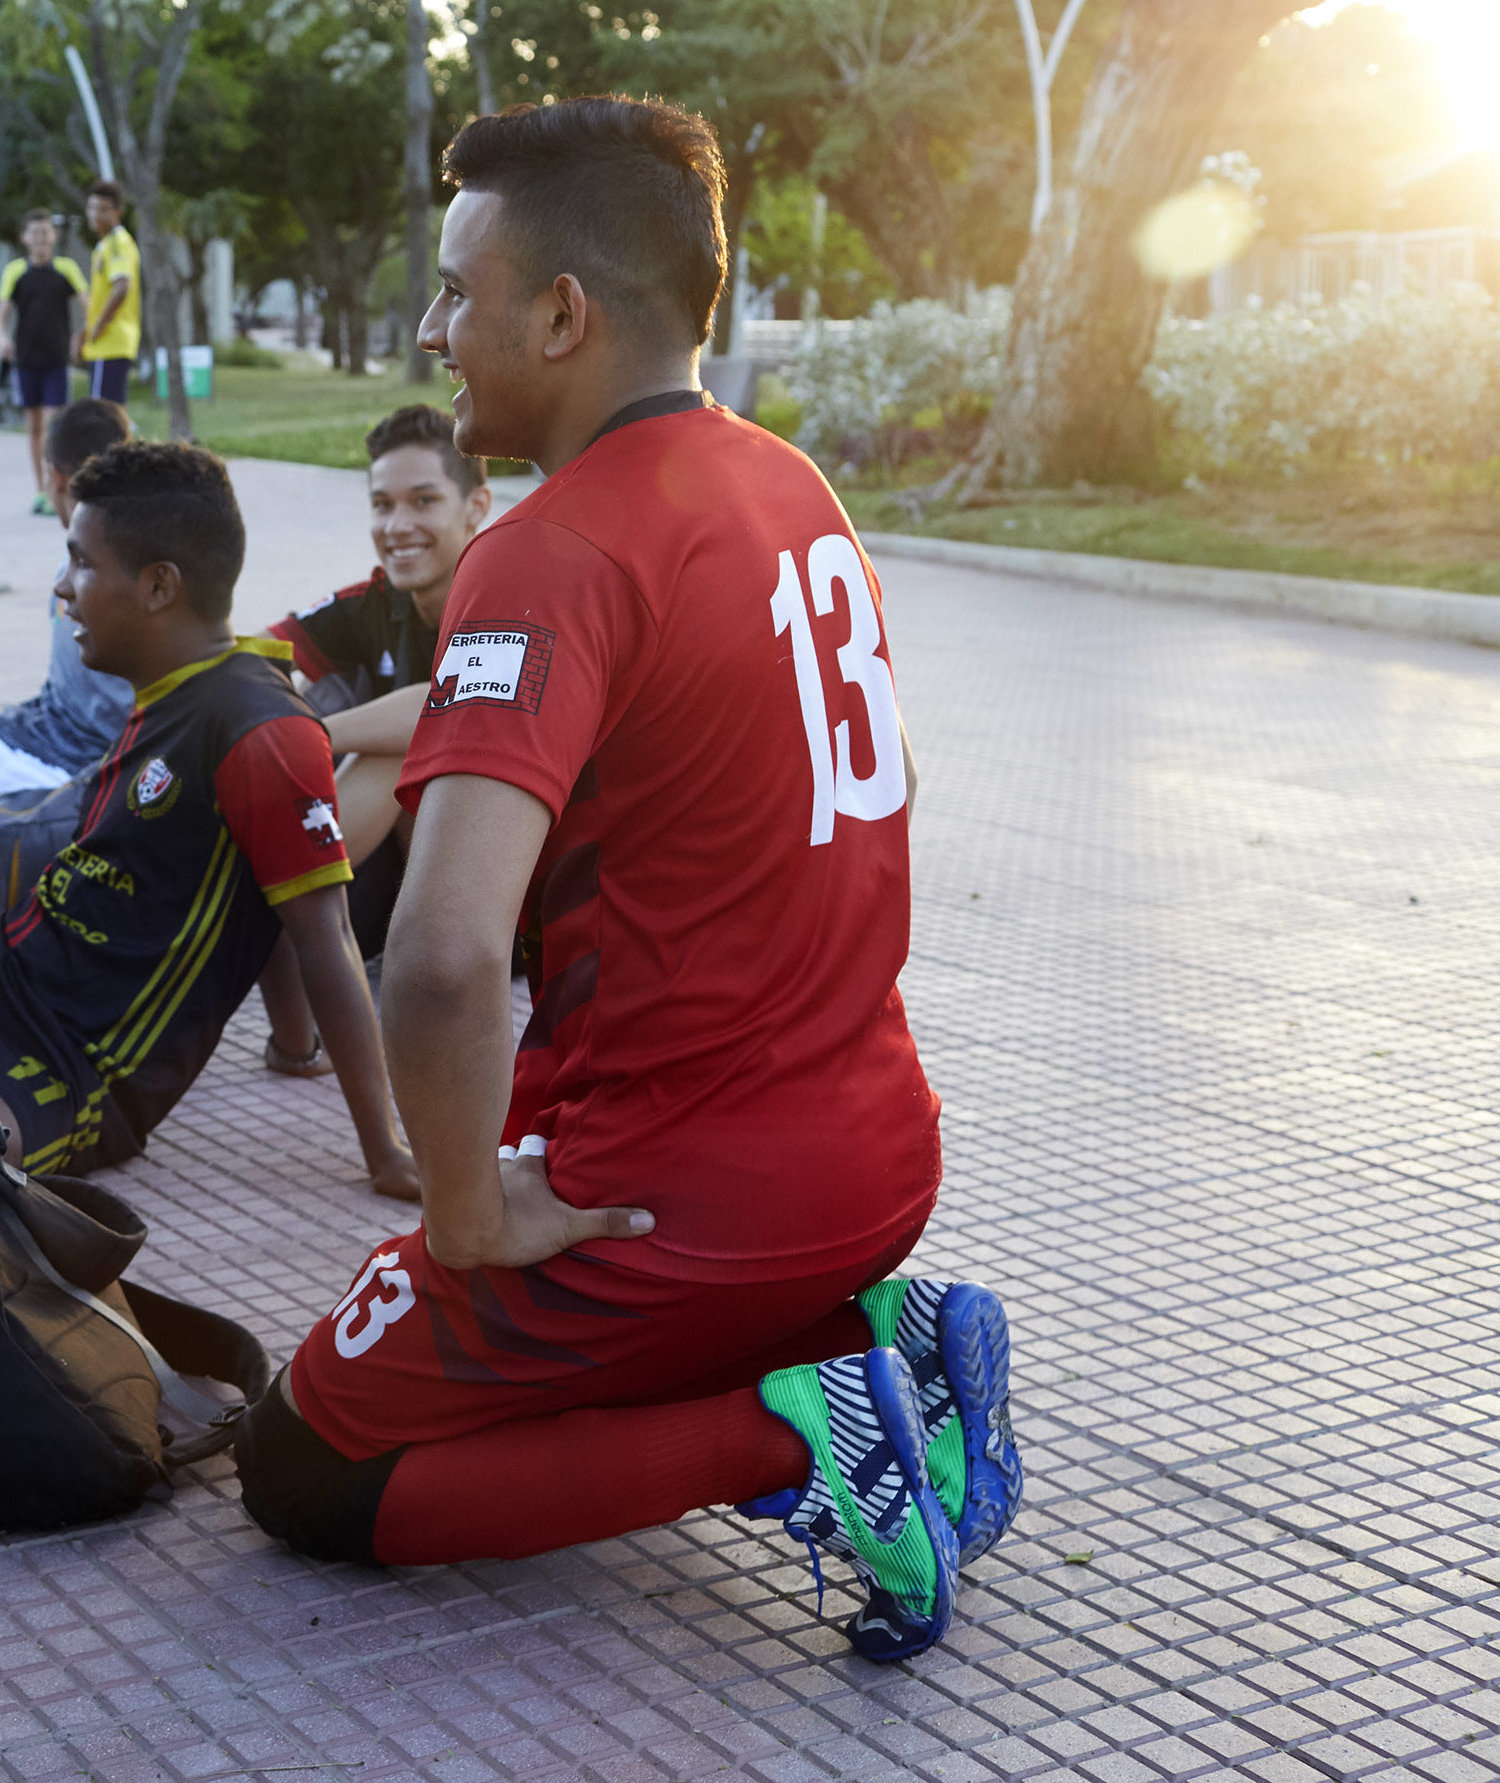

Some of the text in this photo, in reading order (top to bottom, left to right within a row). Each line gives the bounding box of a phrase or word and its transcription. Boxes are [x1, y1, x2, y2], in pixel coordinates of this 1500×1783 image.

[451, 634, 526, 647] ERRETERIA
[467, 656, 483, 668] EL
[770, 534, 906, 846] 13
[331, 1251, 417, 1359] 13
